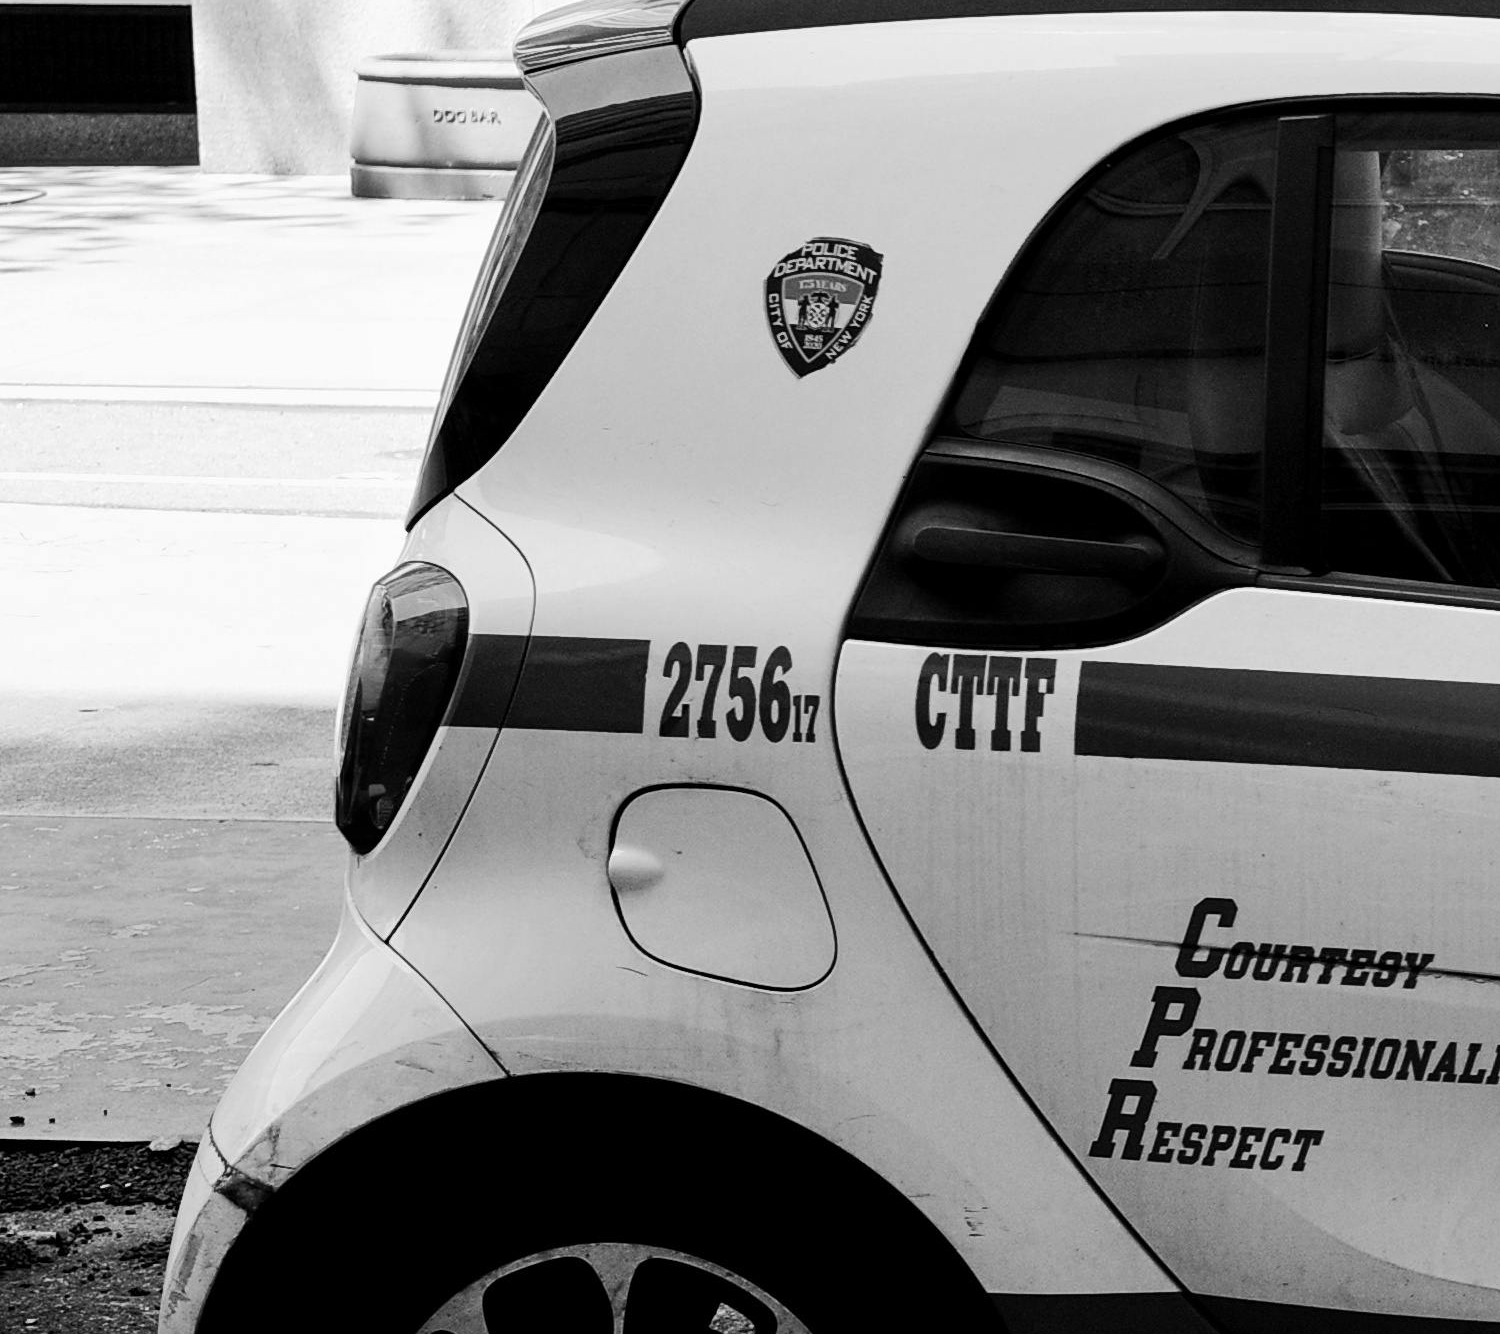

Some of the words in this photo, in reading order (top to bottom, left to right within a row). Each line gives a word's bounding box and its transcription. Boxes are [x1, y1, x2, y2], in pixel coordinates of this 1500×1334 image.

[774, 256, 877, 285] DEPARTMENT
[801, 242, 858, 261] POLICE
[768, 293, 783, 327] CITY
[776, 331, 792, 350] OF
[825, 330, 853, 360] NEW
[851, 295, 874, 329] YORK
[914, 652, 1057, 753] CTTF
[1174, 896, 1436, 990] COURTESY
[1088, 1077, 1325, 1172] RESPECT
